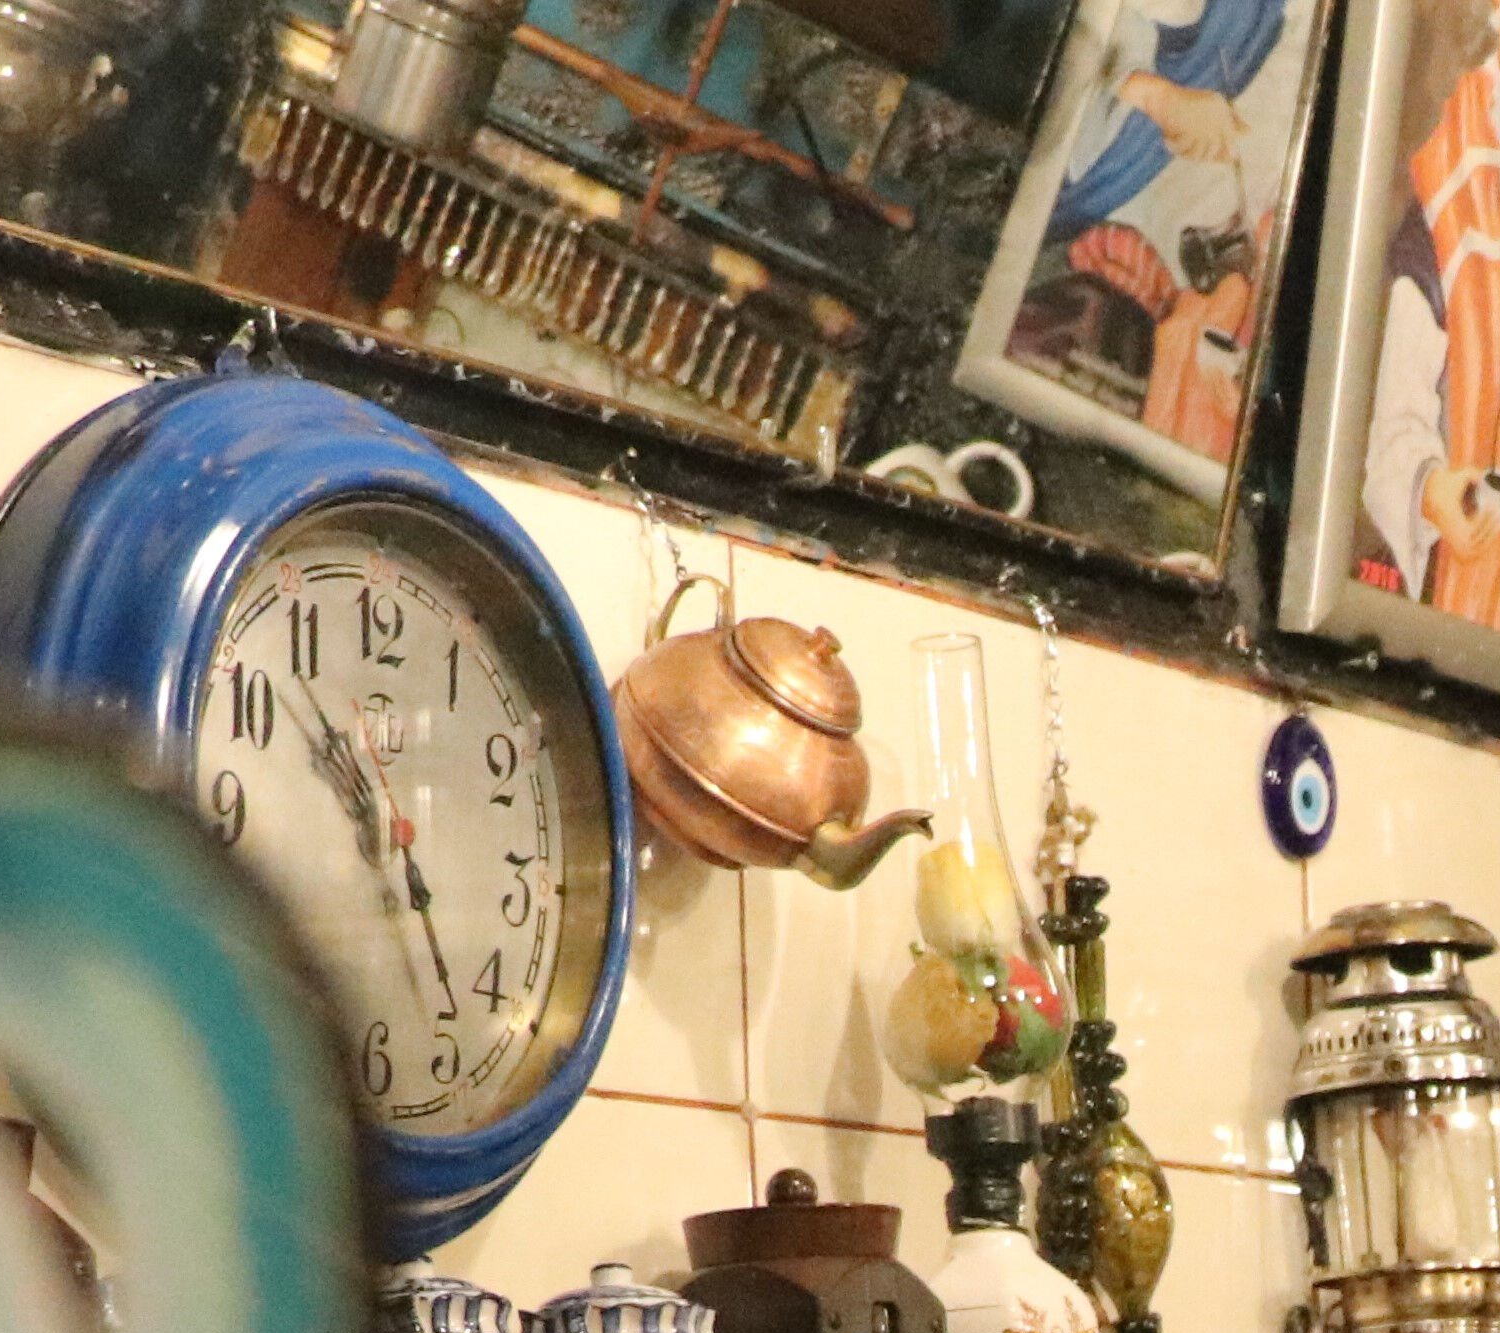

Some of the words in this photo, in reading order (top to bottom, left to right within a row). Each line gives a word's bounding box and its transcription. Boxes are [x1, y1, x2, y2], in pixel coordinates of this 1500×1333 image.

[288, 599, 320, 680] 11
[357, 587, 405, 669] 12
[231, 661, 274, 750] 10
[445, 640, 459, 712] 1
[212, 770, 246, 846] 9
[486, 734, 517, 807] 2
[502, 851, 535, 927] 3
[472, 948, 508, 1013] 4
[362, 1021, 392, 1096] 6
[431, 1011, 460, 1084] 5
